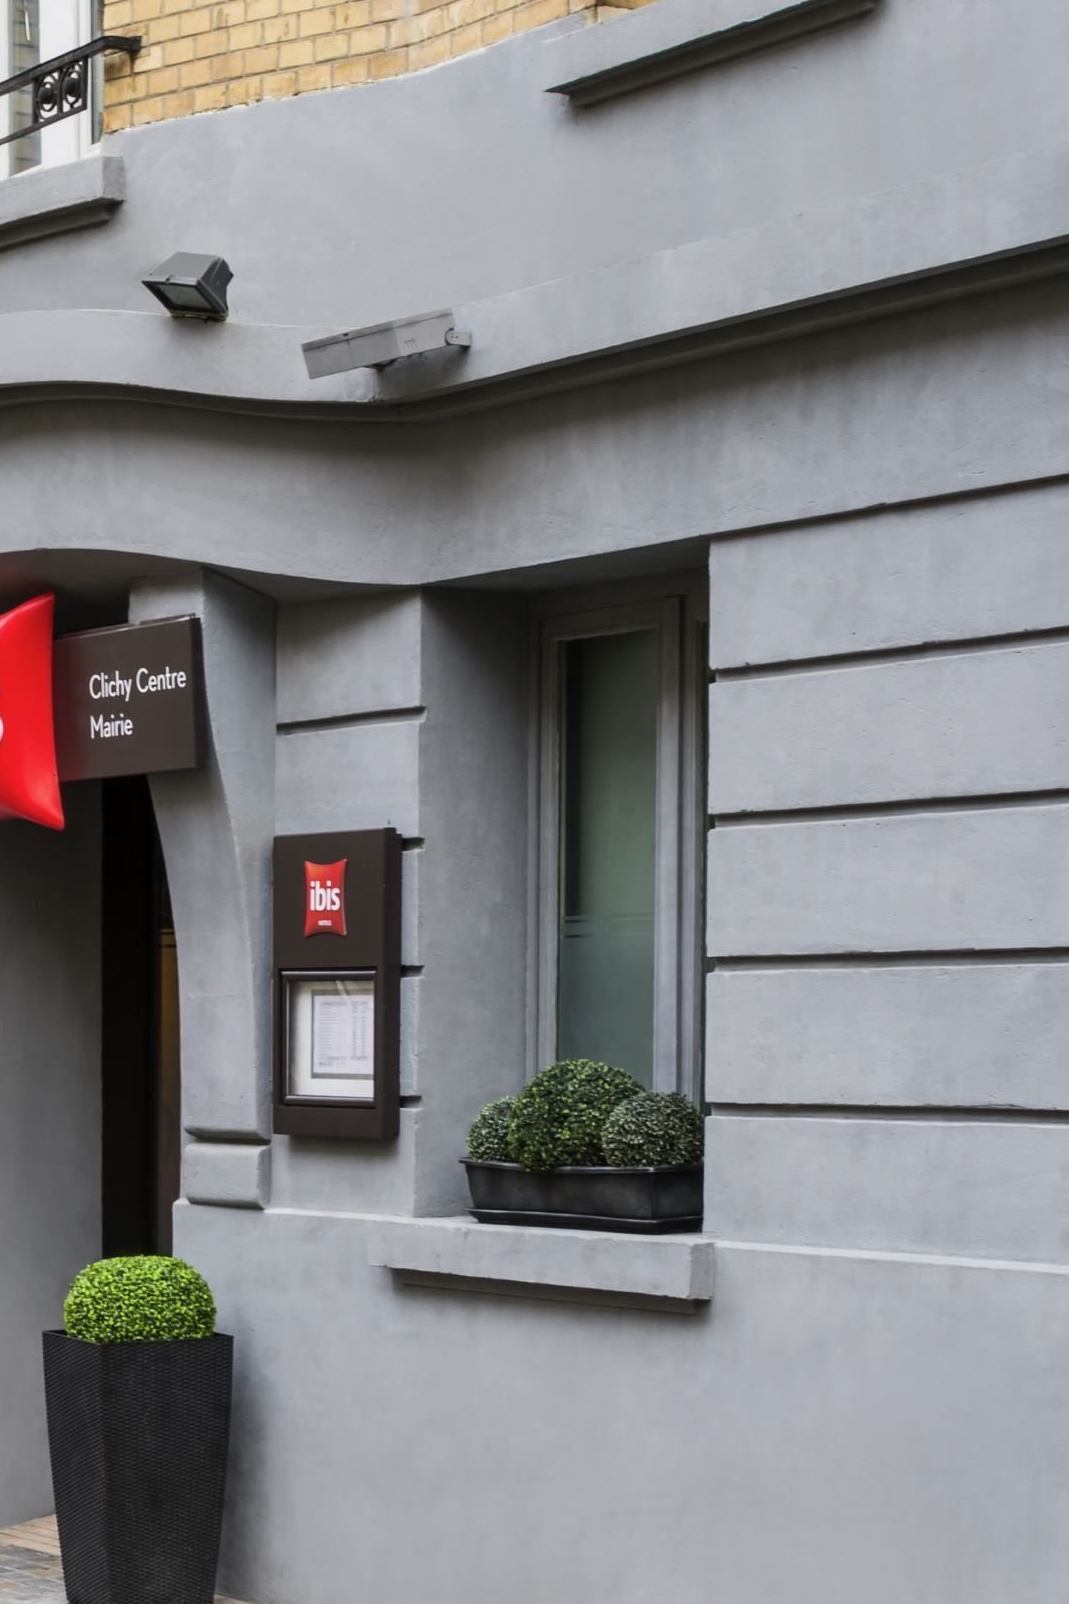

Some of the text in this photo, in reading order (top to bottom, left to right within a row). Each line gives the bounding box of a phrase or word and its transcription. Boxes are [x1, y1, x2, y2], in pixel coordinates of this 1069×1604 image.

[88, 666, 187, 701] Clichy Centre
[89, 714, 133, 739] Mairie
[310, 880, 340, 911] ibis
